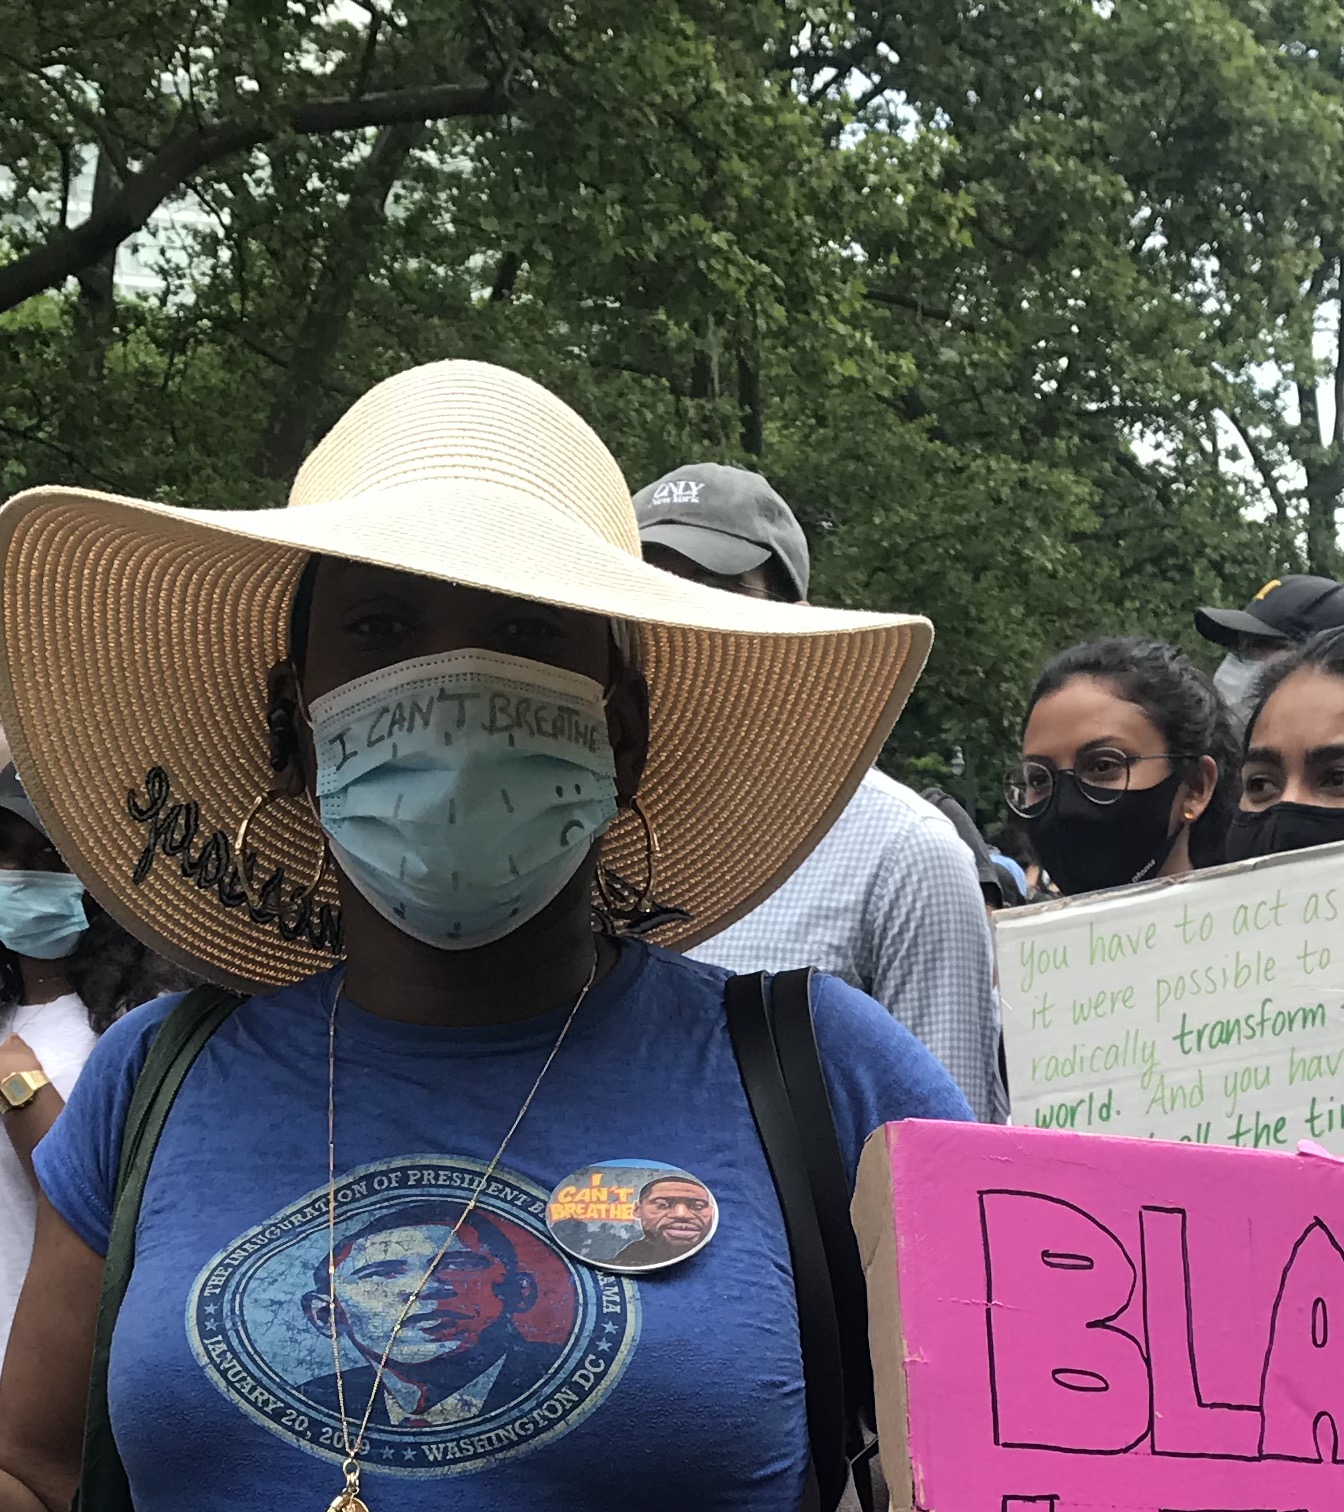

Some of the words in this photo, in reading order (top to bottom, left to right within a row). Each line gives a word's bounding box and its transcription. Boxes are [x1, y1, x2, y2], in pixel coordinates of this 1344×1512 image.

[328, 727, 358, 771] I
[366, 687, 481, 748] CAN'T
[481, 691, 602, 754] BREATHE
[1089, 921, 1157, 966] have
[1174, 903, 1215, 944] to
[1232, 888, 1289, 936] act
[1302, 888, 1339, 925] as
[1031, 991, 1056, 1030] it
[1071, 984, 1137, 1026] were
[1154, 949, 1277, 1022] possible
[1296, 939, 1332, 975] to
[1031, 1028, 1161, 1090] radically
[1171, 997, 1327, 1056] transform
[1034, 1087, 1122, 1128] world.
[1145, 1068, 1205, 1116] And
[1223, 1065, 1271, 1119] you
[1227, 1110, 1288, 1148] the
[549, 1201, 636, 1222] BREATHE
[557, 1184, 635, 1204] CAN'T
[589, 1172, 604, 1188] I
[203, 1265, 232, 1297] THE
[373, 1170, 403, 1191] OF
[407, 1169, 532, 1207] PRESIDENT
[203, 1333, 285, 1415] JANUARY
[421, 1385, 581, 1462] WASHINGTON
[572, 1353, 606, 1391] DC
